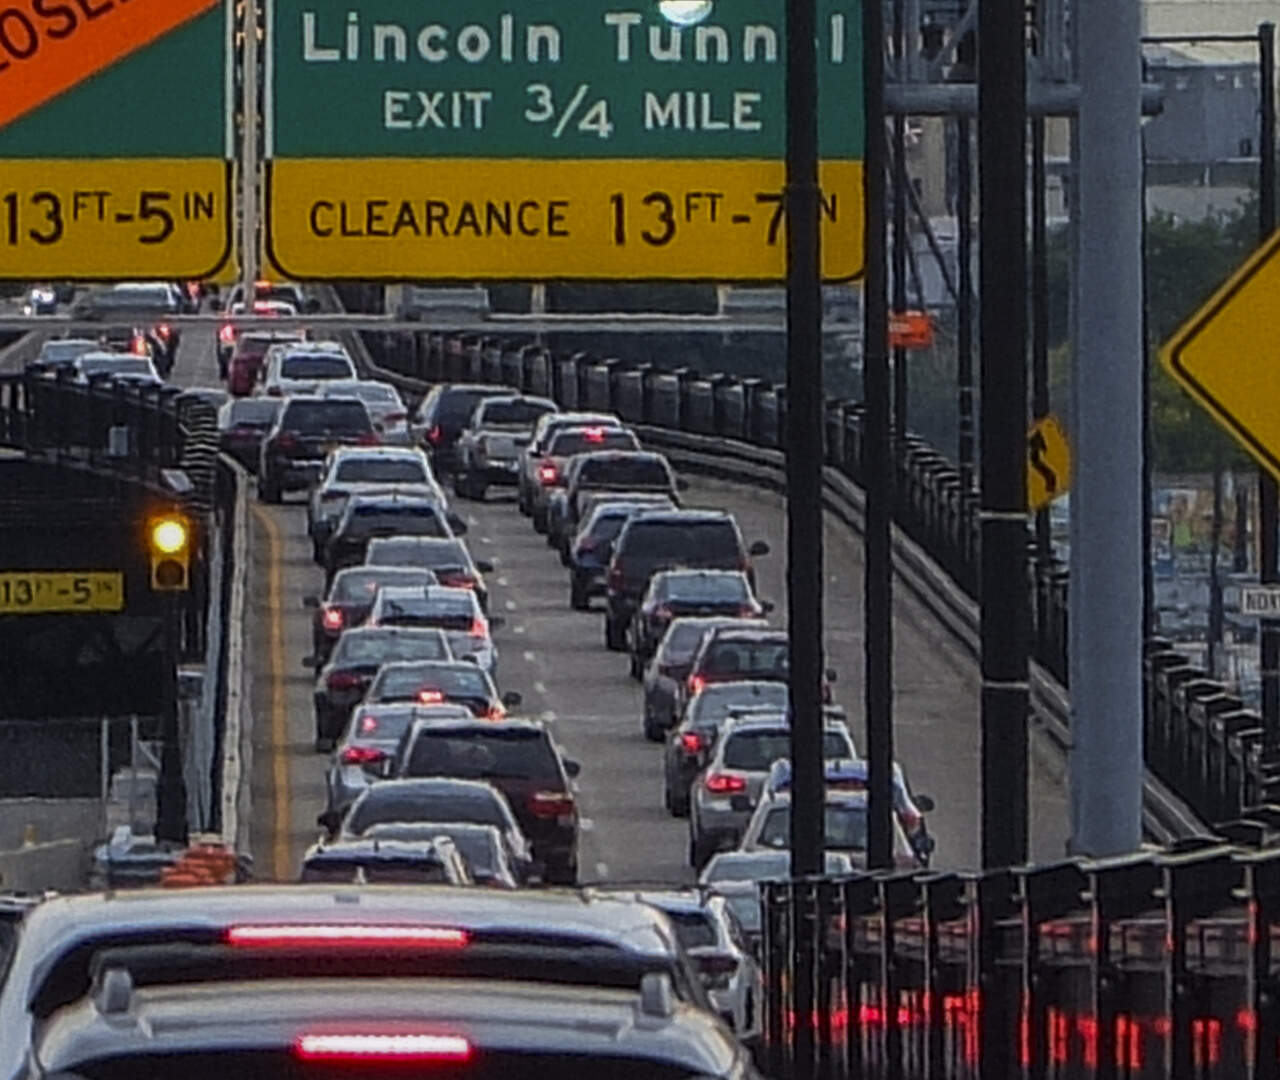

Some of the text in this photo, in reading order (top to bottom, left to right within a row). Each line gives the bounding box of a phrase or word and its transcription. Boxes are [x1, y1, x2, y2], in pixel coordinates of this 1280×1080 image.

[302, 12, 844, 63] Lincoln Tunnl
[385, 84, 762, 138] EXIT 3/4 MILE
[310, 200, 570, 237] CLEARANCE
